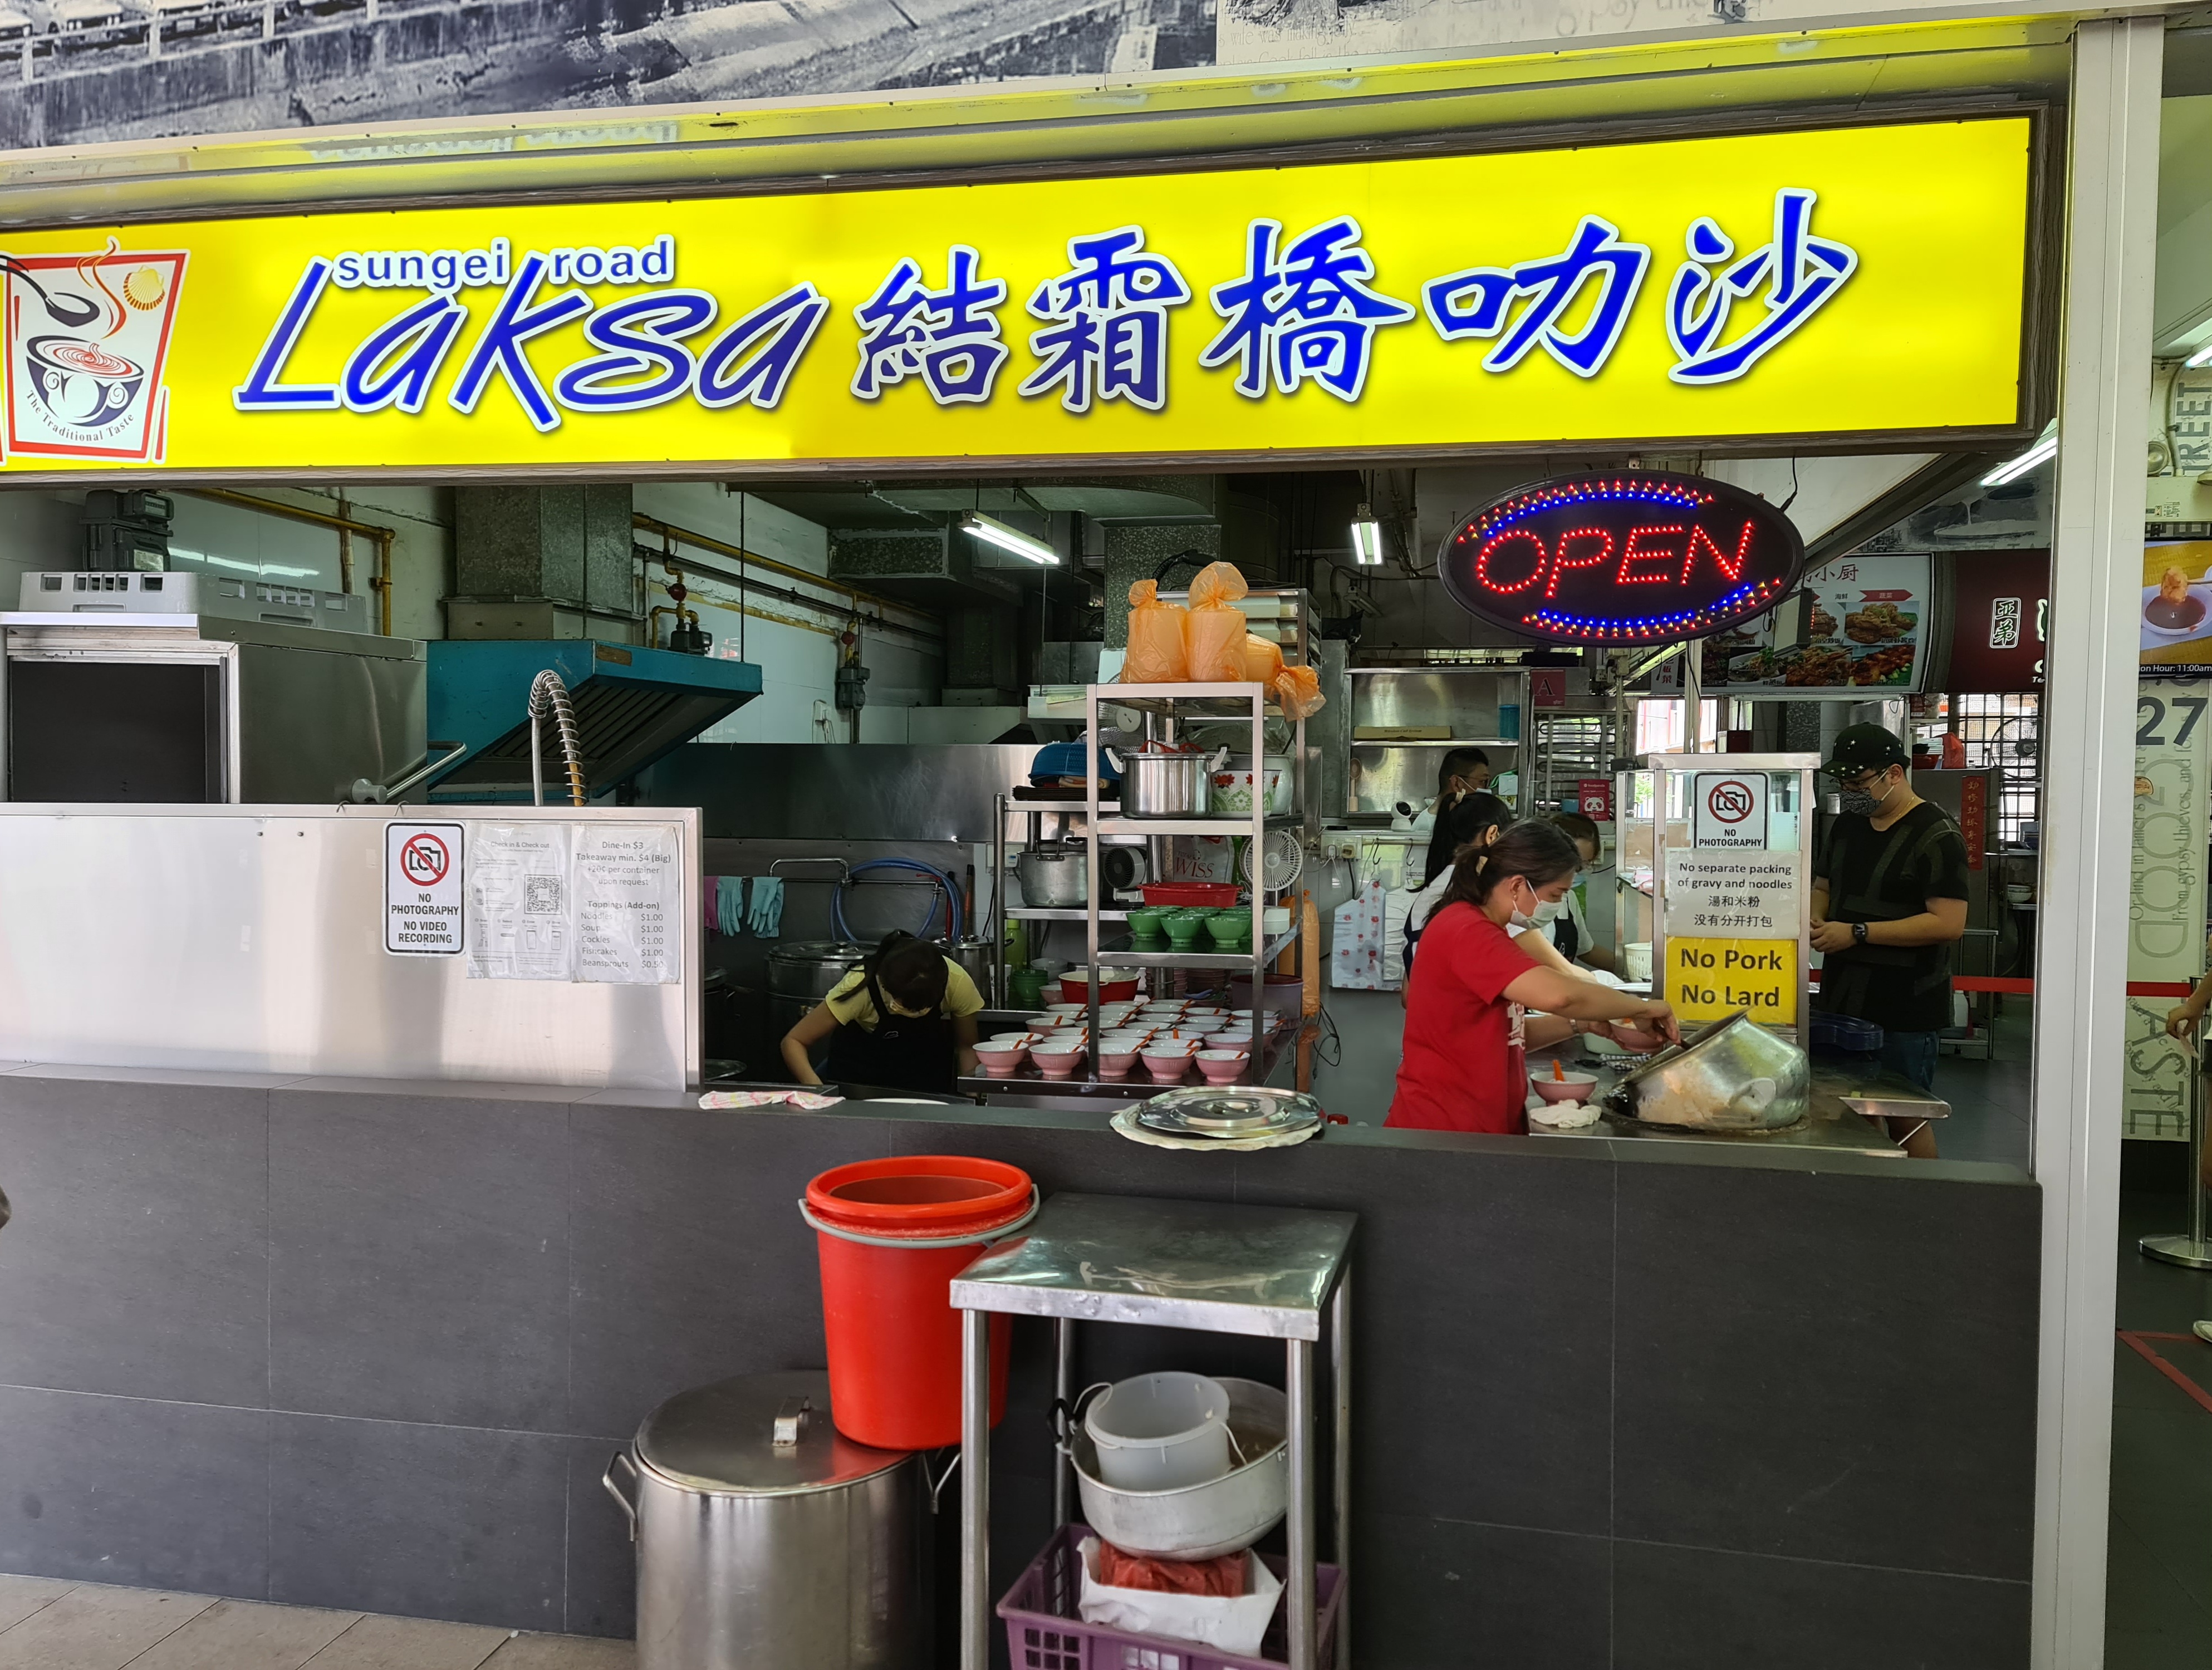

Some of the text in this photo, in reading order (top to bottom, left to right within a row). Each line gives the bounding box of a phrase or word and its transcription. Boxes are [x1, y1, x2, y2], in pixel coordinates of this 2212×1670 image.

[339, 240, 669, 288] sungei road
[858, 194, 1851, 410] 結霜橋叻沙
[27, 390, 134, 441] The Traditional Taste
[1475, 519, 1755, 599] OPEN
[1534, 677, 1555, 696] A
[2174, 759, 2191, 783] and
[602, 841, 644, 849] Dine-In $3
[1699, 838, 1763, 847] PHOTOGRAPHY
[576, 853, 616, 862] Takeaway
[619, 853, 636, 862] min.
[651, 854, 671, 863] (Big)
[1176, 857, 1214, 878] WISS
[1680, 863, 1792, 875] No separate packing
[2178, 847, 2195, 885] gypsy
[619, 878, 649, 887] request
[1678, 877, 1792, 889] of gravy and noodles
[419, 893, 431, 902] NO
[1708, 895, 1760, 908] 湯和米粉
[391, 905, 459, 916] PHOTOGRAPHY
[587, 900, 660, 911] Toppings (Add-on)
[404, 921, 447, 931] NO VIDEO
[1694, 914, 1773, 927] 没有分开打包
[581, 924, 601, 932] Soup
[398, 933, 452, 943] RECORDING
[582, 947, 617, 955] Fishcakes
[582, 959, 629, 967] Beansprouts
[1681, 948, 1783, 970] No Pork
[1681, 984, 1780, 1007] No Lard
[2128, 980, 2189, 1137] ASTE
